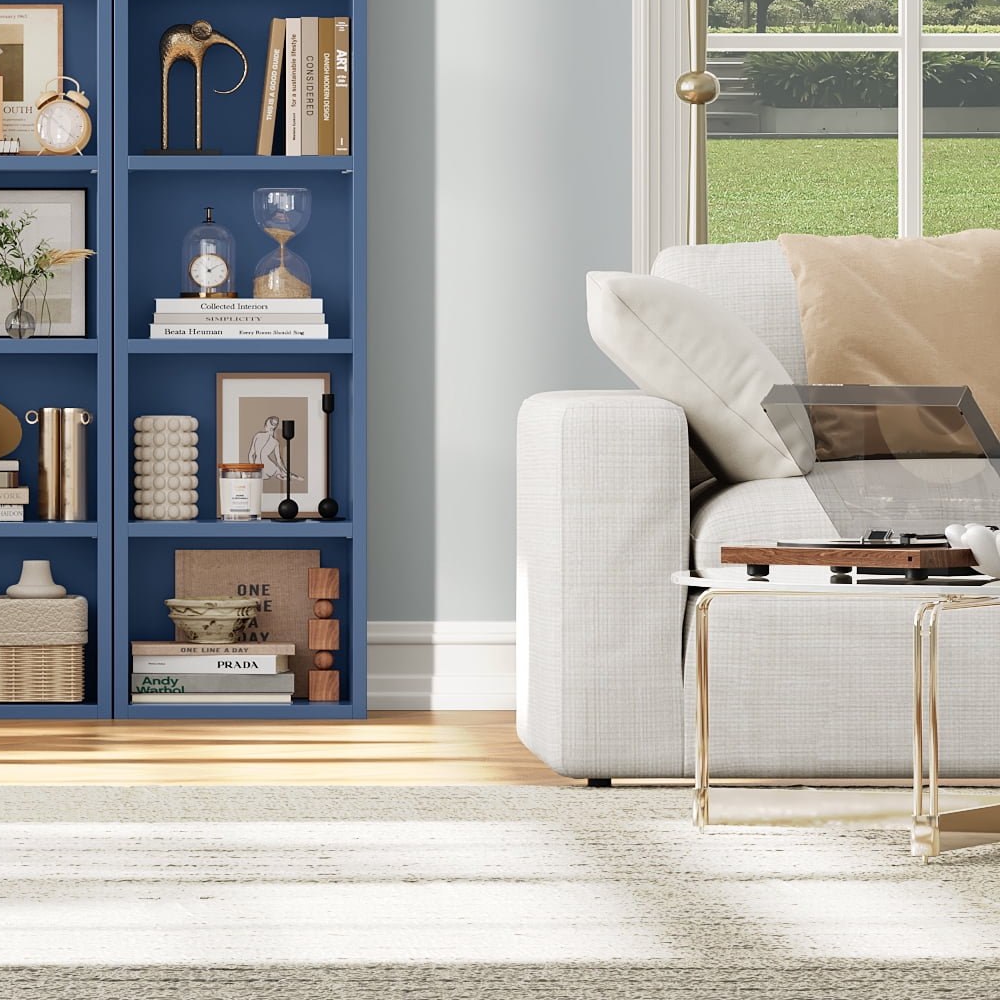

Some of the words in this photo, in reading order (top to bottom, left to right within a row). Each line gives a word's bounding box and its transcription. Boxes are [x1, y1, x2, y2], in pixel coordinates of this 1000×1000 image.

[336, 49, 348, 72] ART
[306, 55, 314, 116] CONSIDERED
[237, 584, 271, 596] ONE
[217, 661, 259, 669] PRADA
[142, 676, 179, 688] Andy
